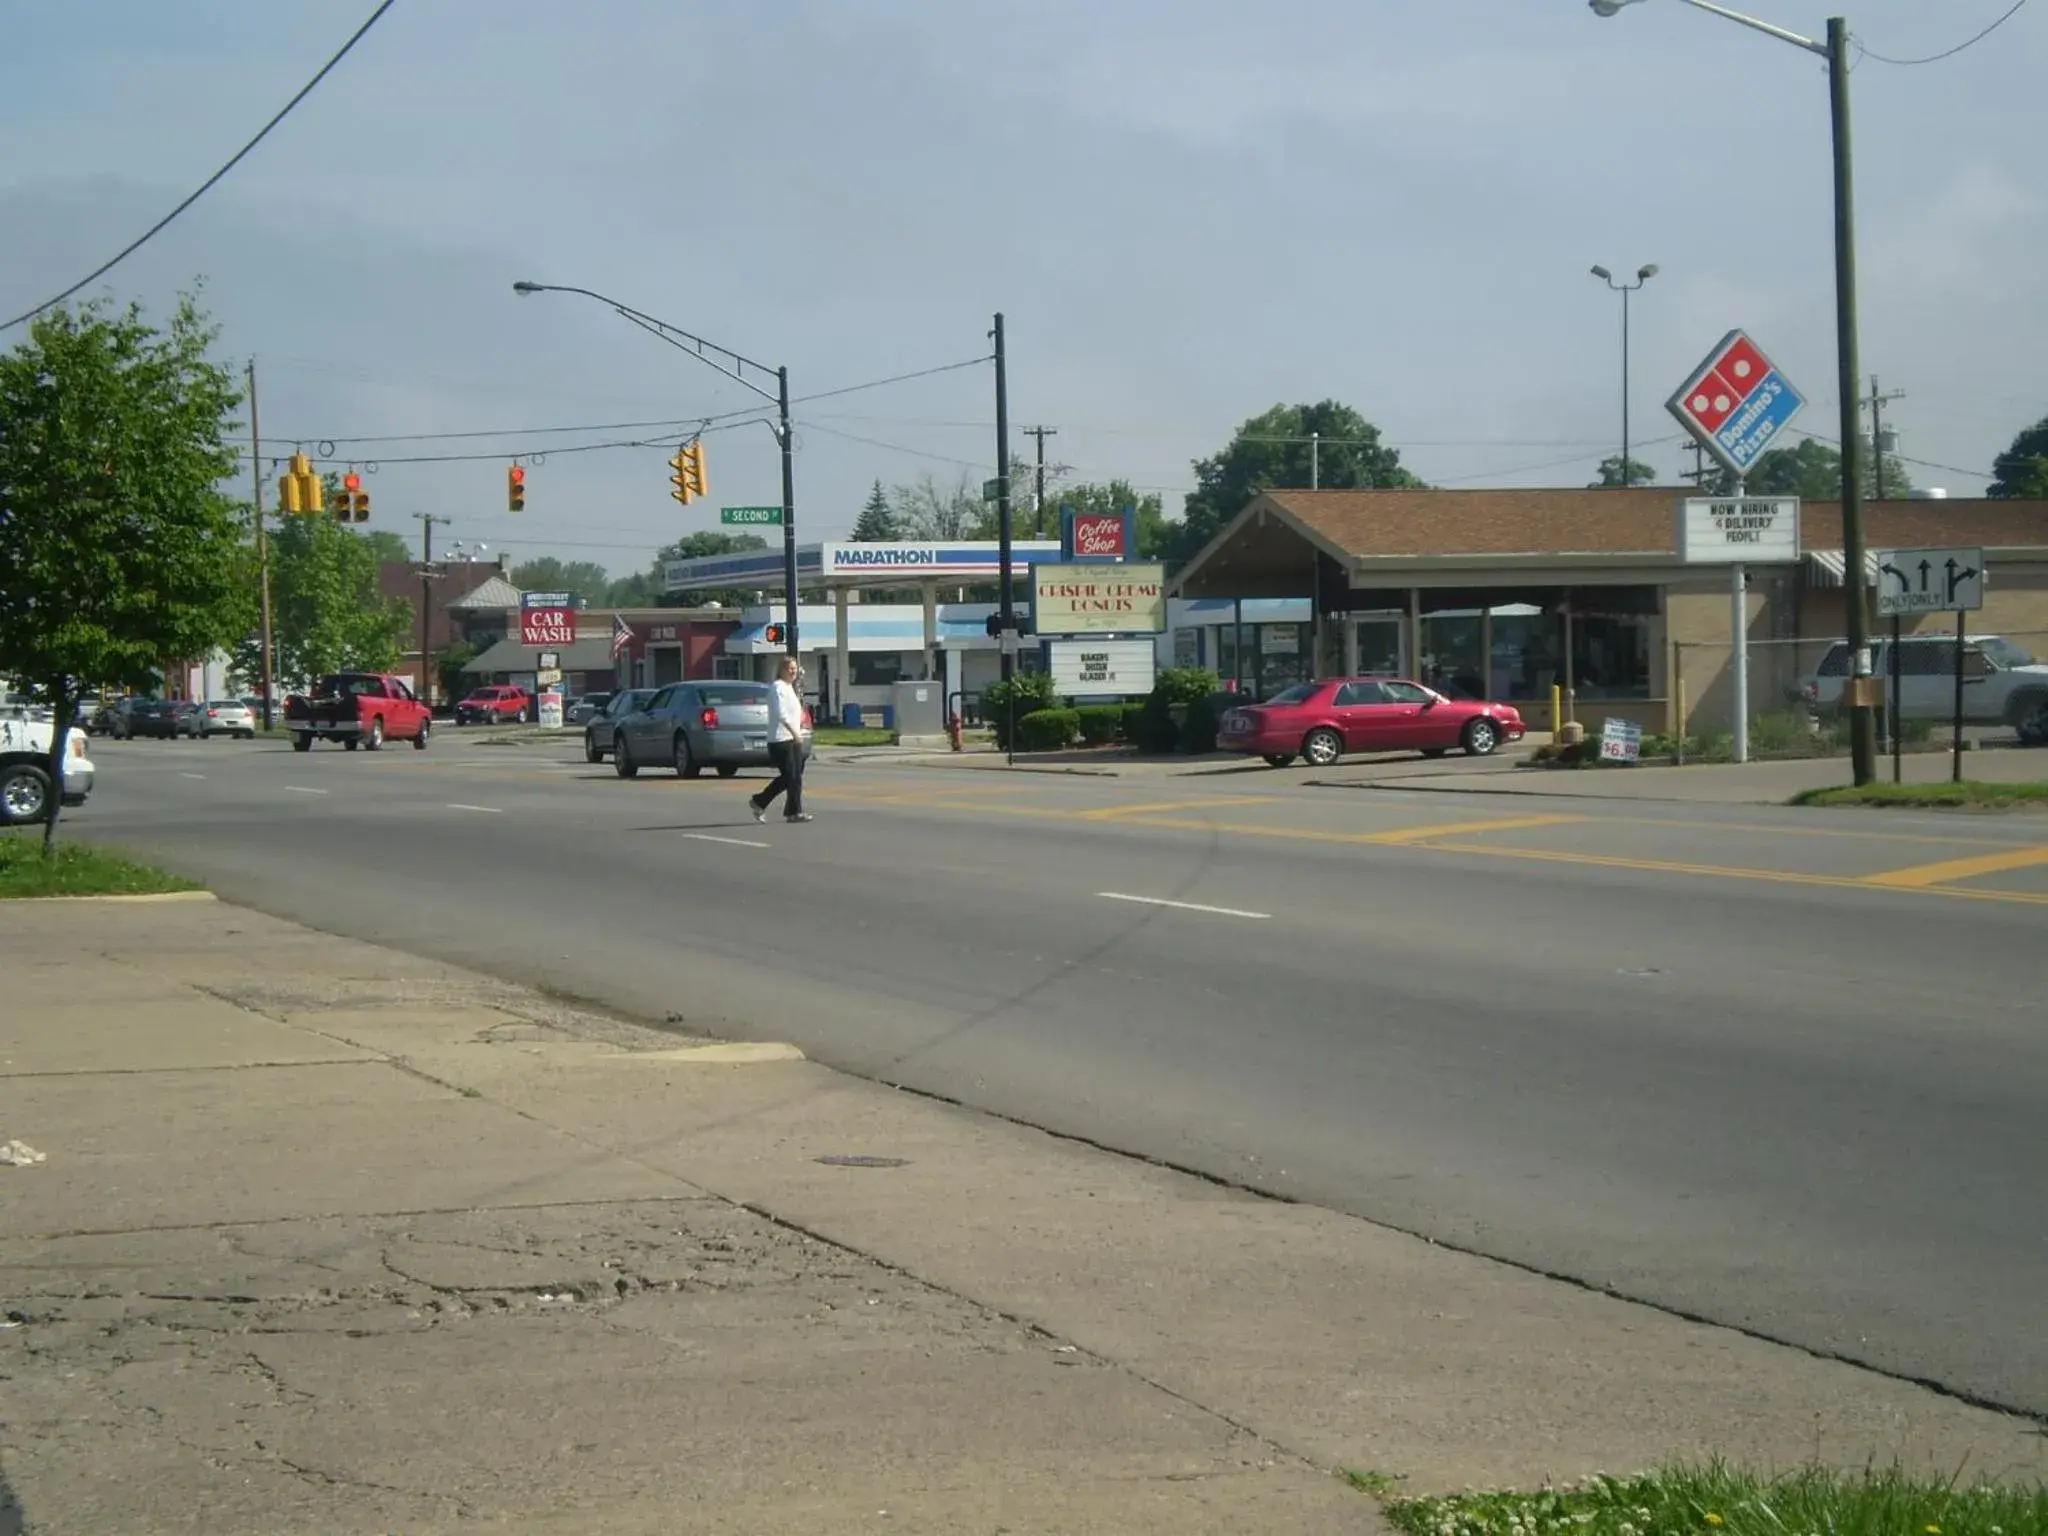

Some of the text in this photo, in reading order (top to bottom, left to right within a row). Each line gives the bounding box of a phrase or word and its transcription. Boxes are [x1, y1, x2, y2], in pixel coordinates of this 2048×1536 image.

[1719, 381, 1782, 449] Domino's
[1732, 417, 1774, 463] Pizza
[732, 510, 769, 521] SECOND
[1710, 502, 1779, 516] NOW HIRING
[1078, 519, 1120, 541] Coffee
[1725, 516, 1773, 530] DELIVERY
[1083, 537, 1116, 553] Shop
[834, 549, 933, 564] MARATHON
[1071, 599, 1132, 612] DONUTS
[1881, 592, 1941, 608] ONLY ONLY
[530, 612, 565, 627] CAR
[524, 627, 572, 642] WASH
